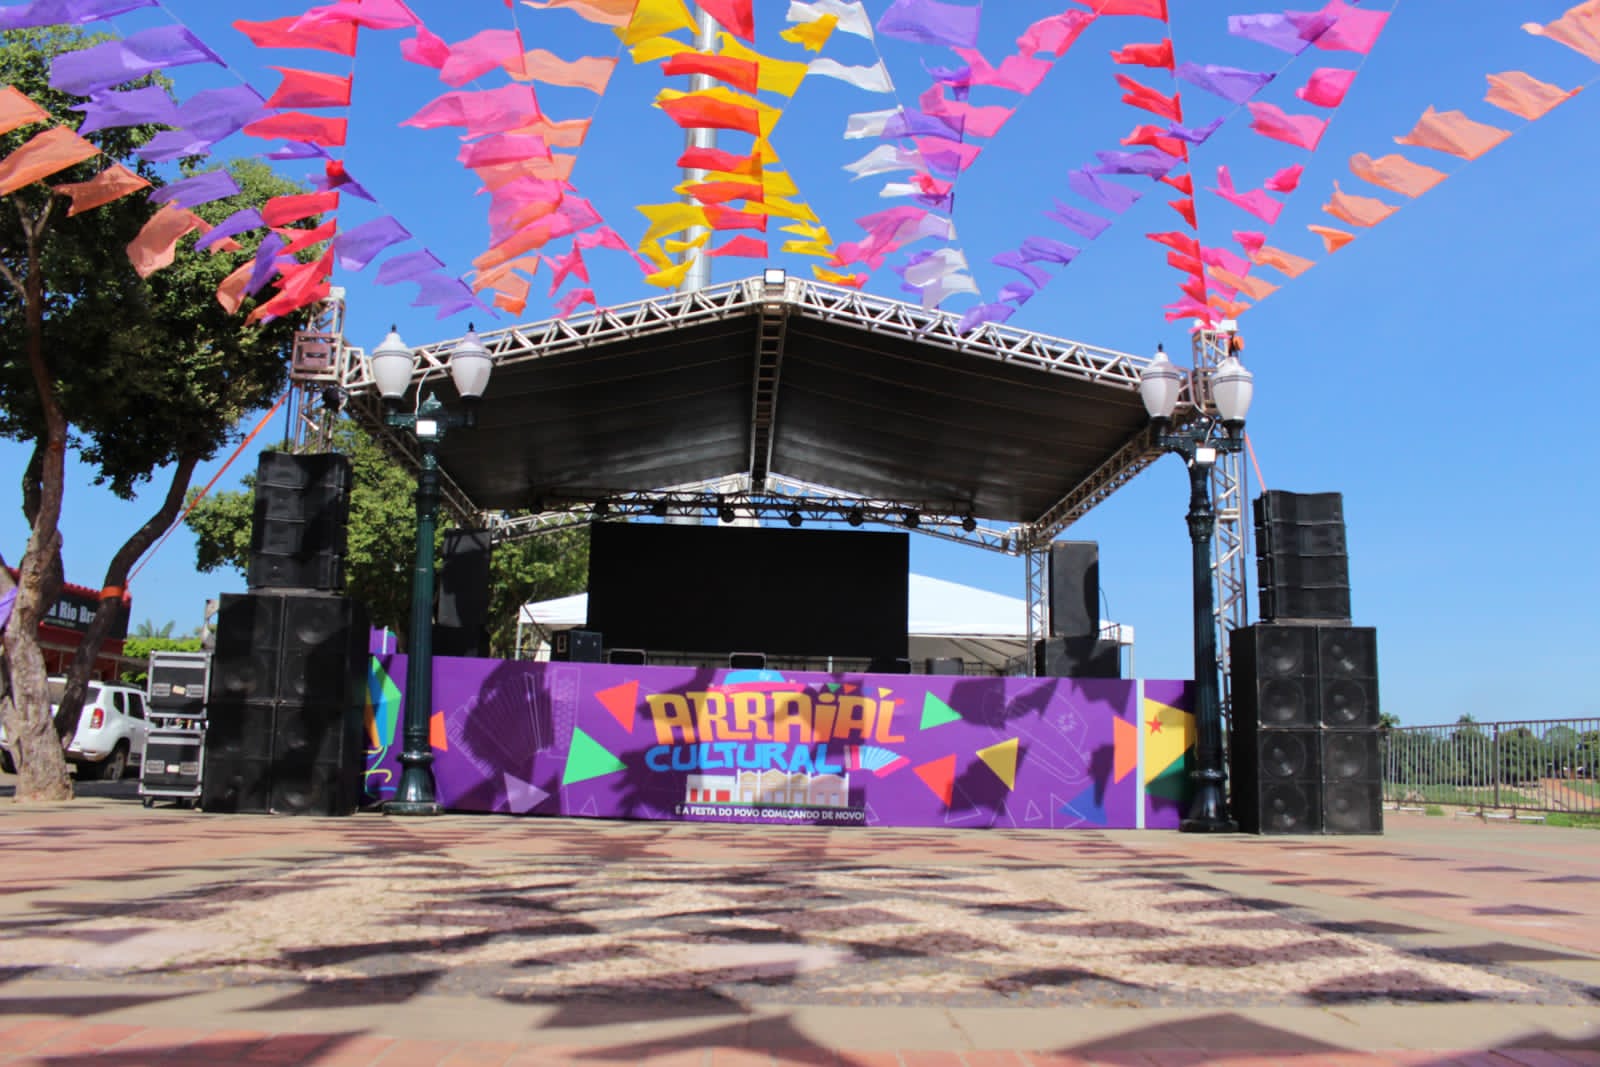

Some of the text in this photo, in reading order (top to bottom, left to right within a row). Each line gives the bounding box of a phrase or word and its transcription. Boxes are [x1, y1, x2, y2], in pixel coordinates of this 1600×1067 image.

[59, 600, 77, 621] Rio
[645, 741, 843, 773] CULTURAL
[682, 805, 690, 816] A
[691, 805, 717, 816] FESTA
[719, 807, 732, 817] DO
[734, 807, 760, 817] POVO
[761, 808, 820, 820] COMEÇANDO
[821, 810, 834, 820] DE
[835, 811, 865, 821] NOVO!
